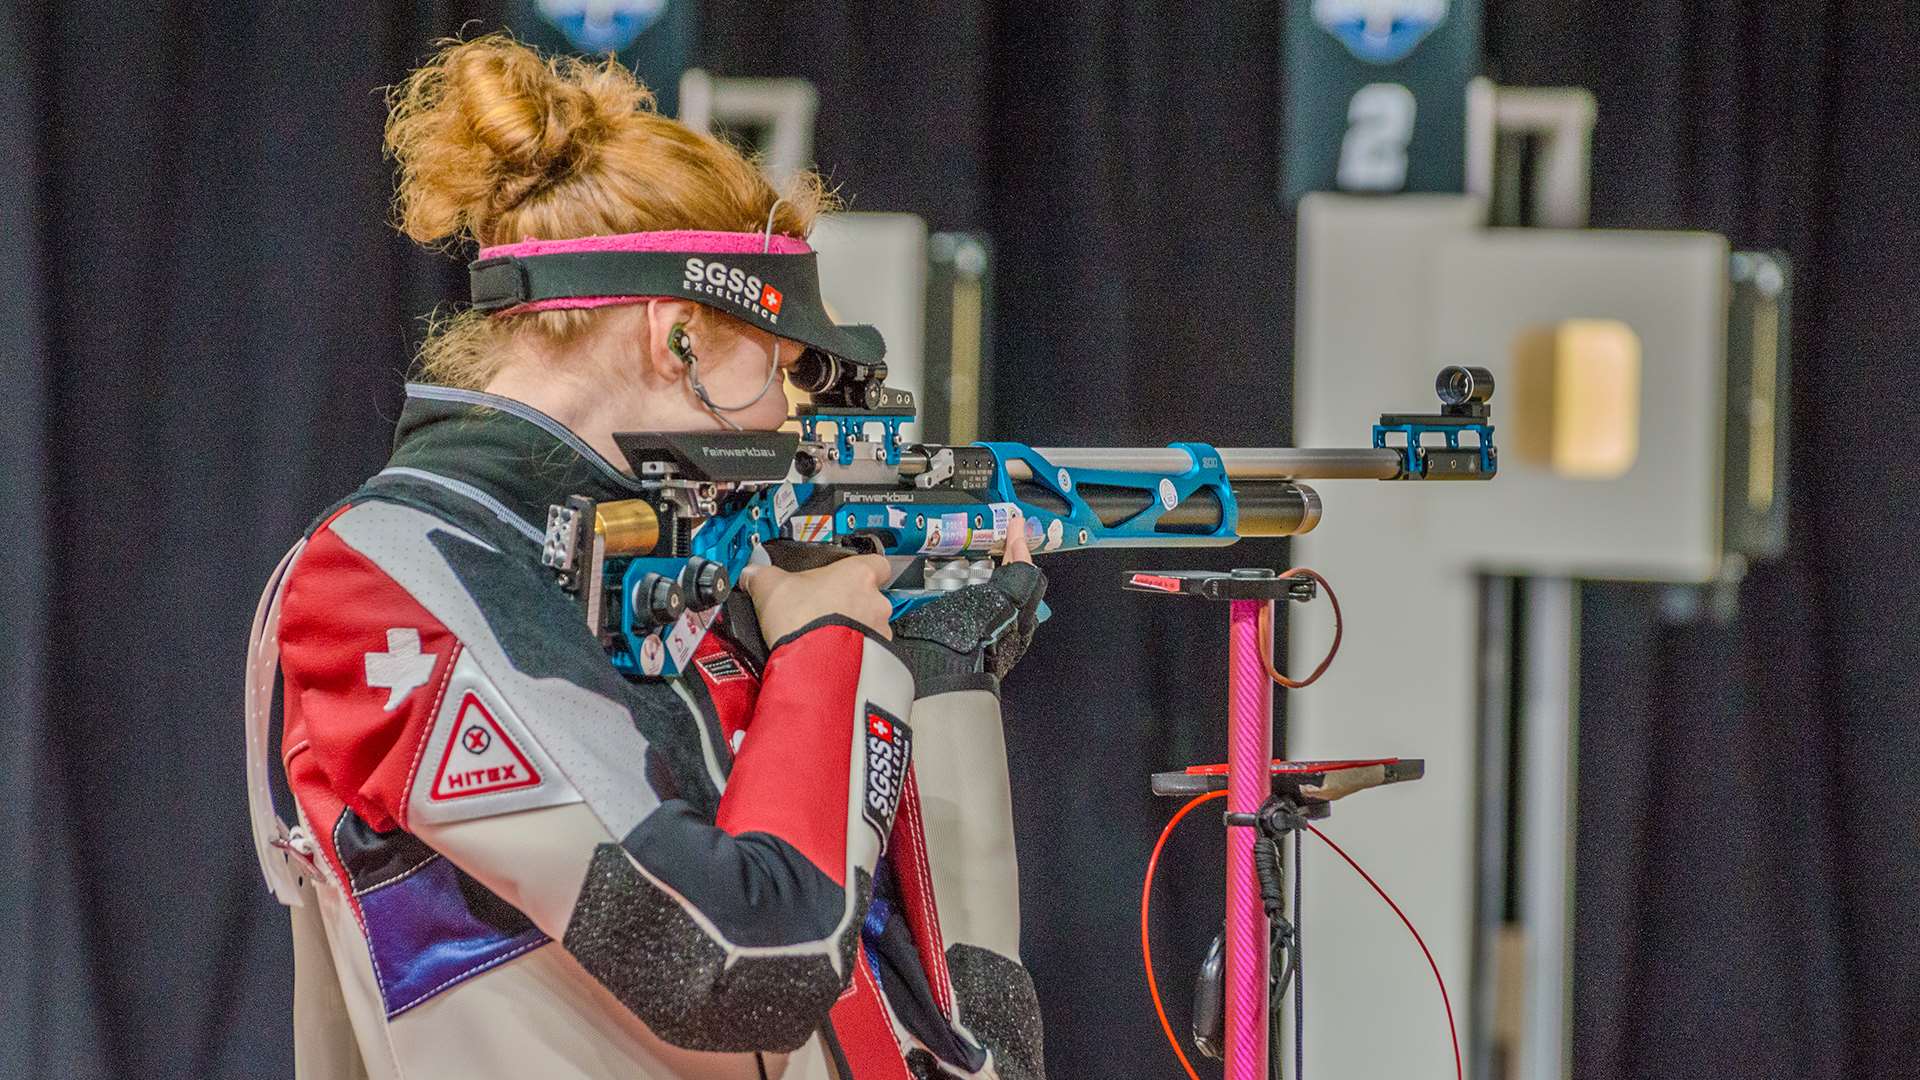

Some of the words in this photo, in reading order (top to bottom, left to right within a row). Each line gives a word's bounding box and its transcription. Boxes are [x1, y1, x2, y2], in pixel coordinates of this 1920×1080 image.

[684, 257, 762, 301] SGSS
[683, 280, 778, 325] EXCELLENCE
[702, 447, 776, 457] Feinwerkbau
[843, 491, 914, 502] Feinwerkbau
[448, 764, 517, 789] HITEX
[868, 736, 893, 817] SGSS
